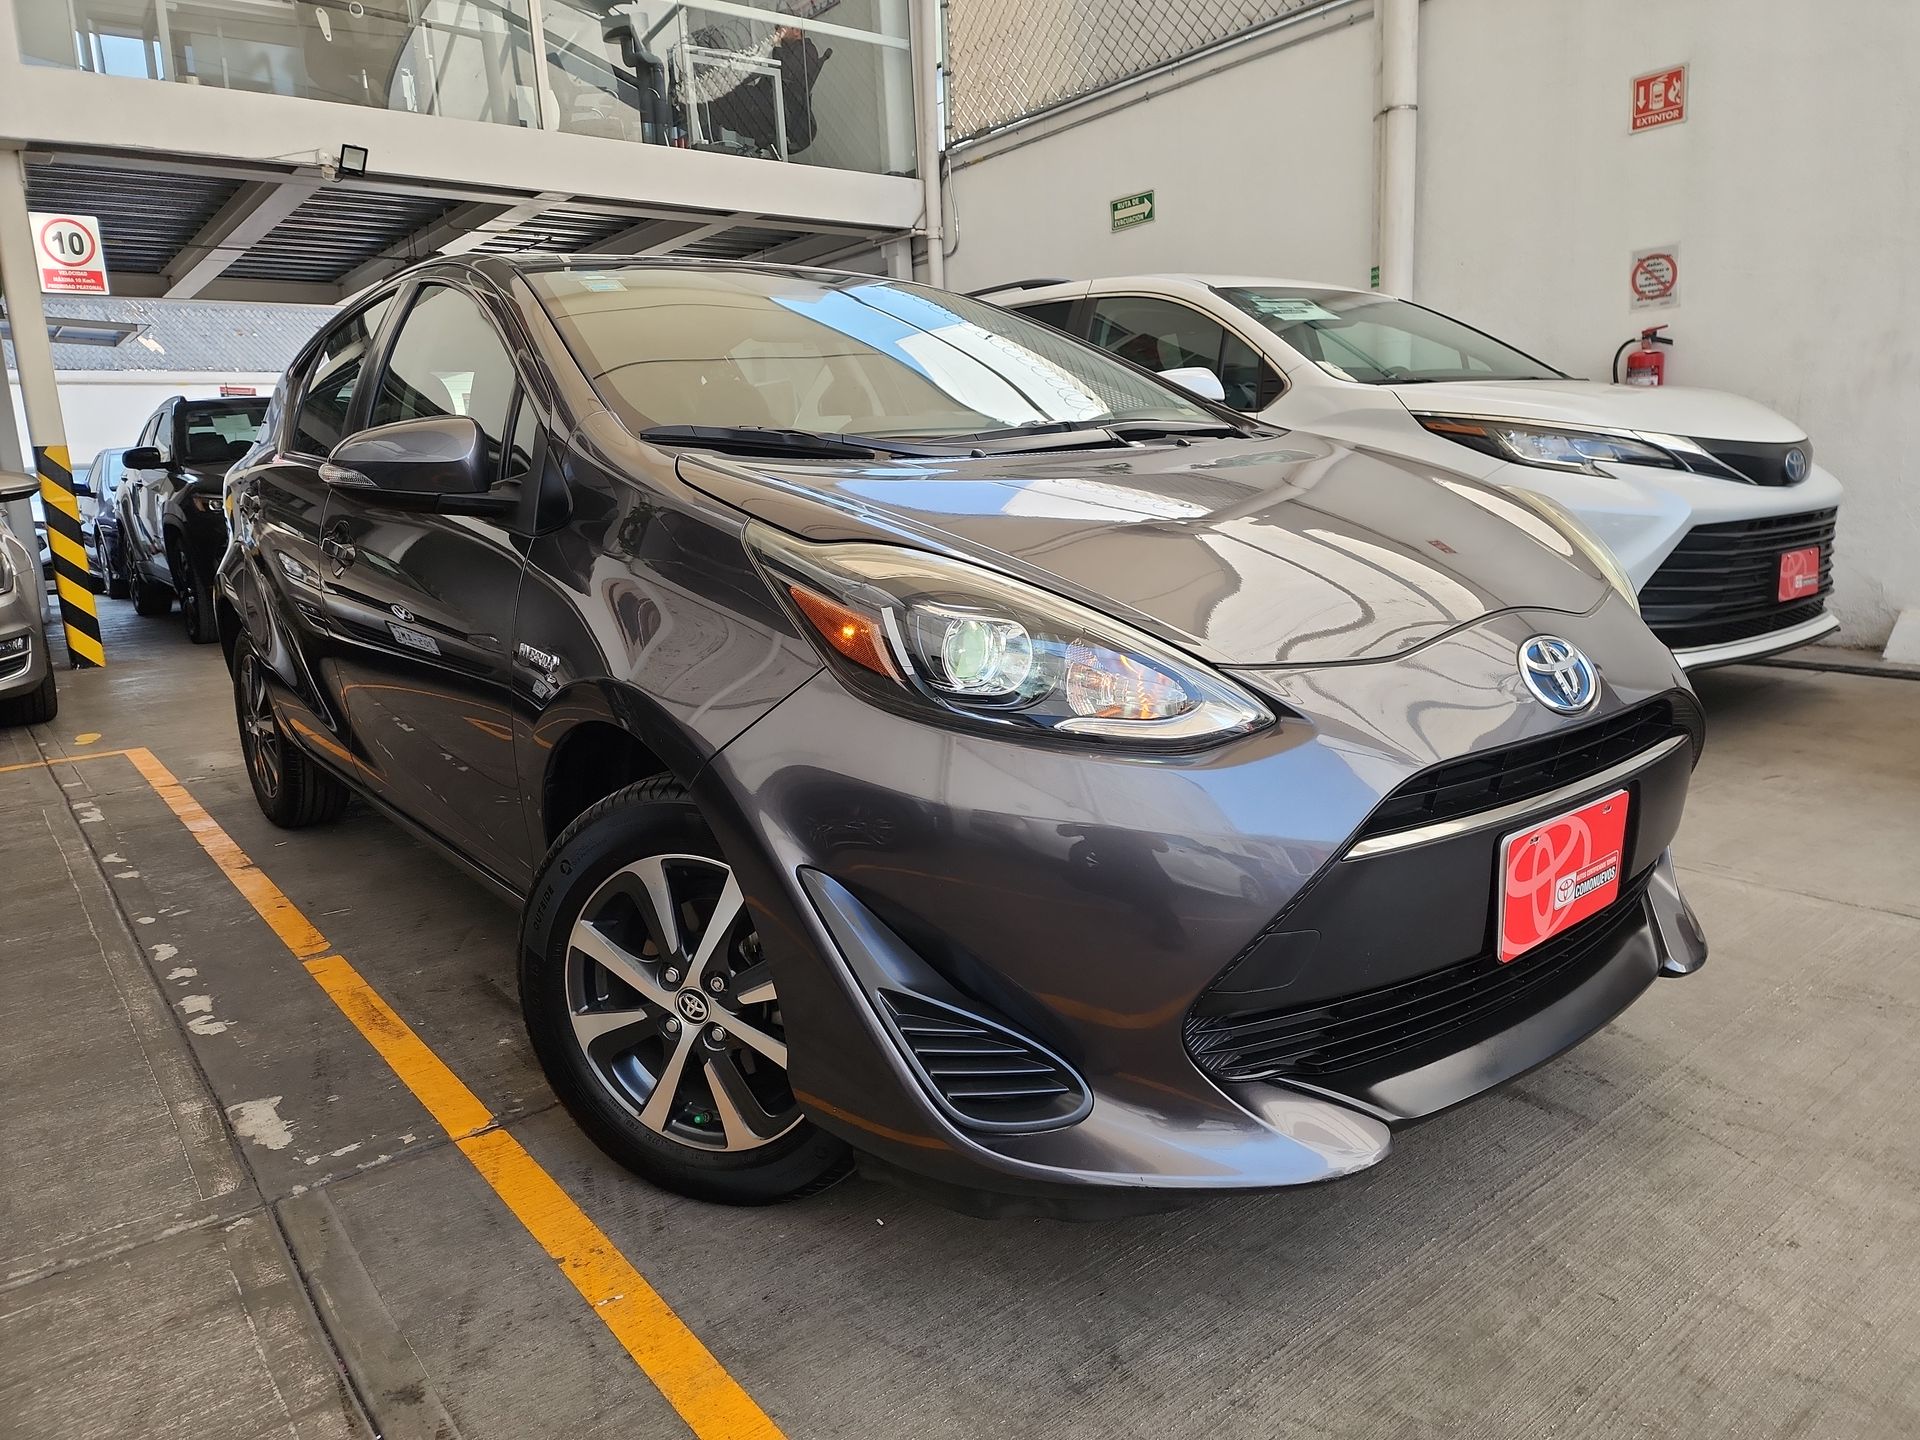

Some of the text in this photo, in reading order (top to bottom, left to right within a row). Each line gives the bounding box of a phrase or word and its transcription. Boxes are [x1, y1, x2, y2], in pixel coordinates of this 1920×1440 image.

[1636, 109, 1680, 127] EXTINTOR
[1117, 197, 1140, 210] RUTA DE
[51, 231, 84, 256] 10
[1575, 866, 1616, 898] COMONUEVOS
[532, 883, 554, 931] OUTSIDE
